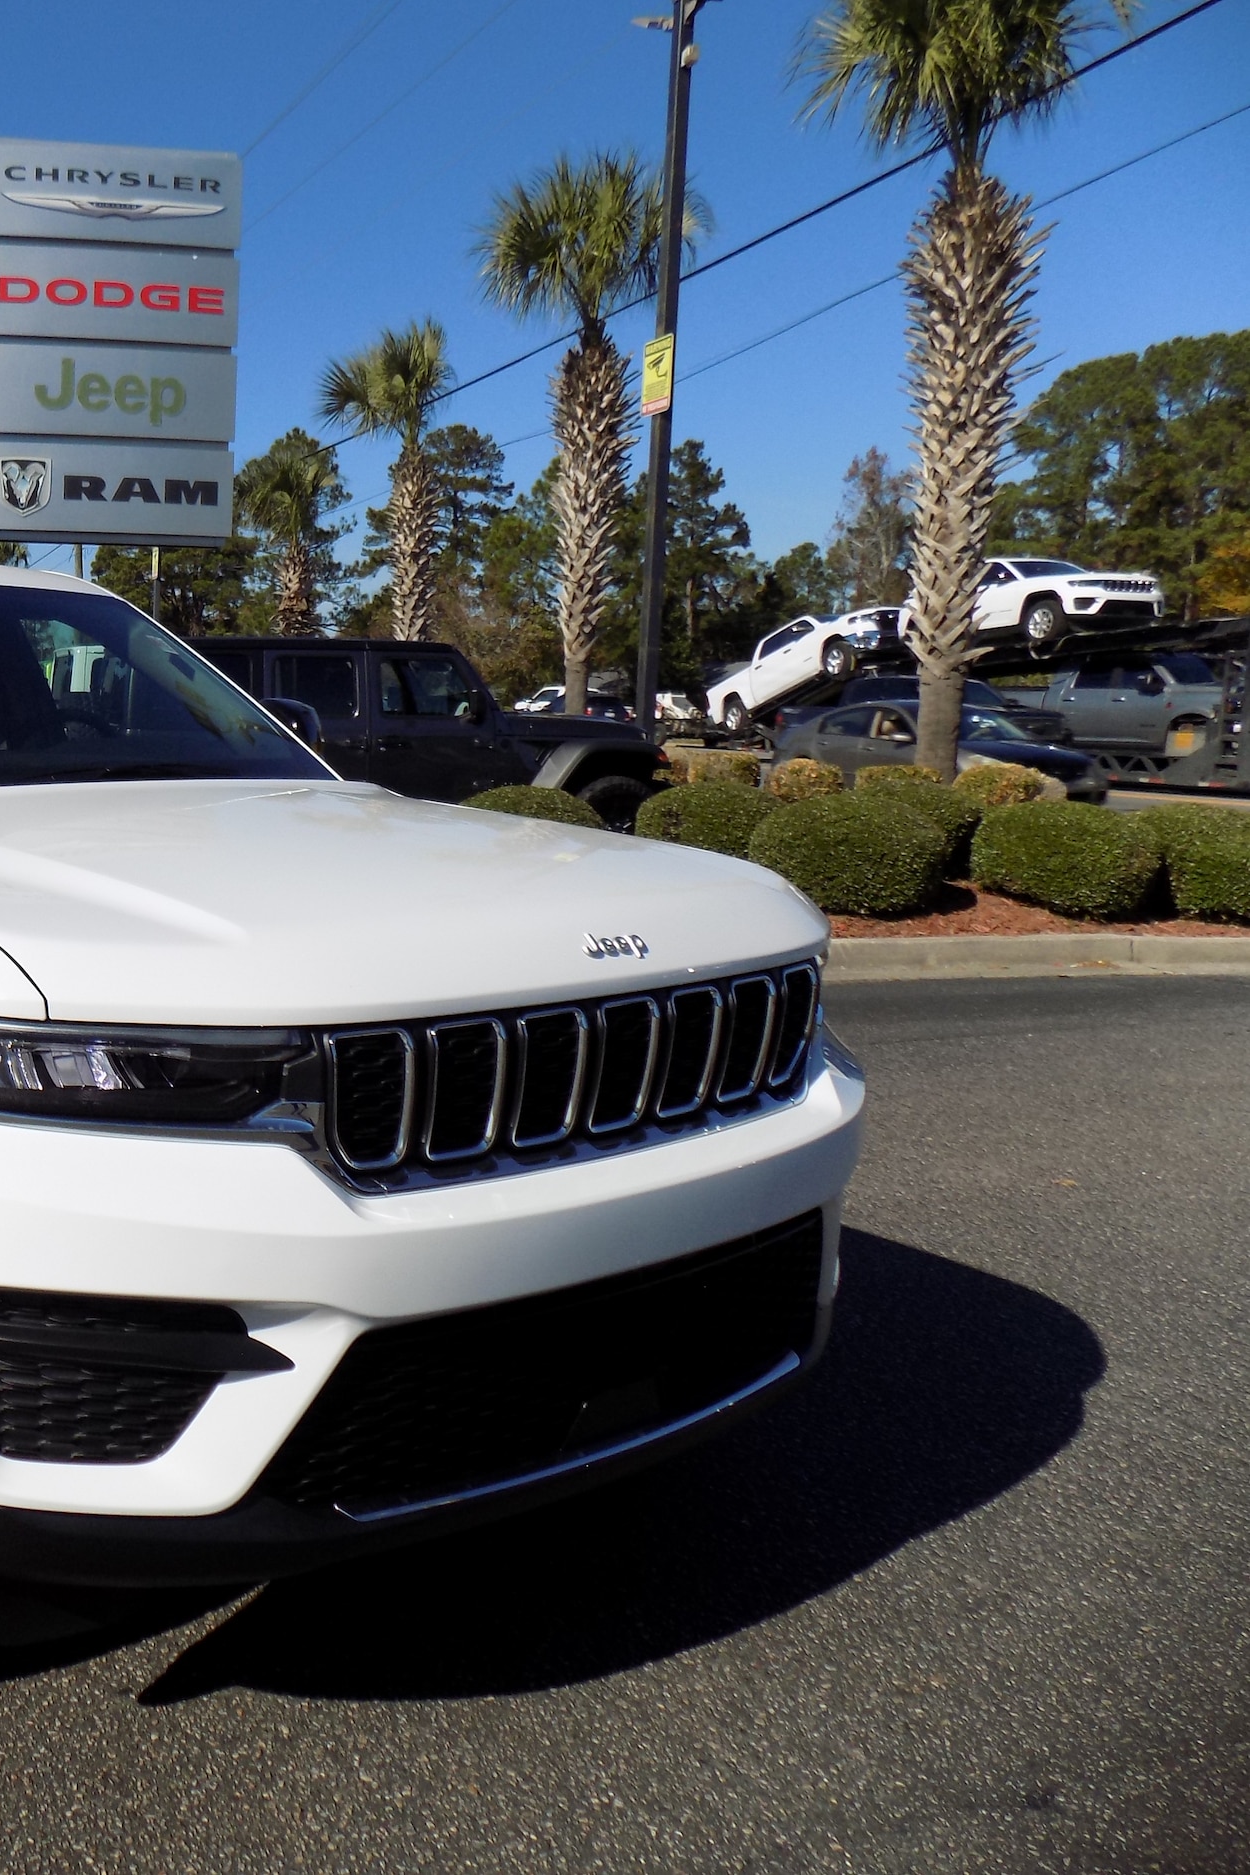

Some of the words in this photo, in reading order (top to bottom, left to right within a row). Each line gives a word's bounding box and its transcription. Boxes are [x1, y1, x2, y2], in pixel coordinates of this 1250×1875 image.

[3, 165, 222, 195] CHRYSLER
[34, 358, 186, 426] Jeep
[63, 474, 218, 507] RAM
[582, 932, 649, 960] Jeep
